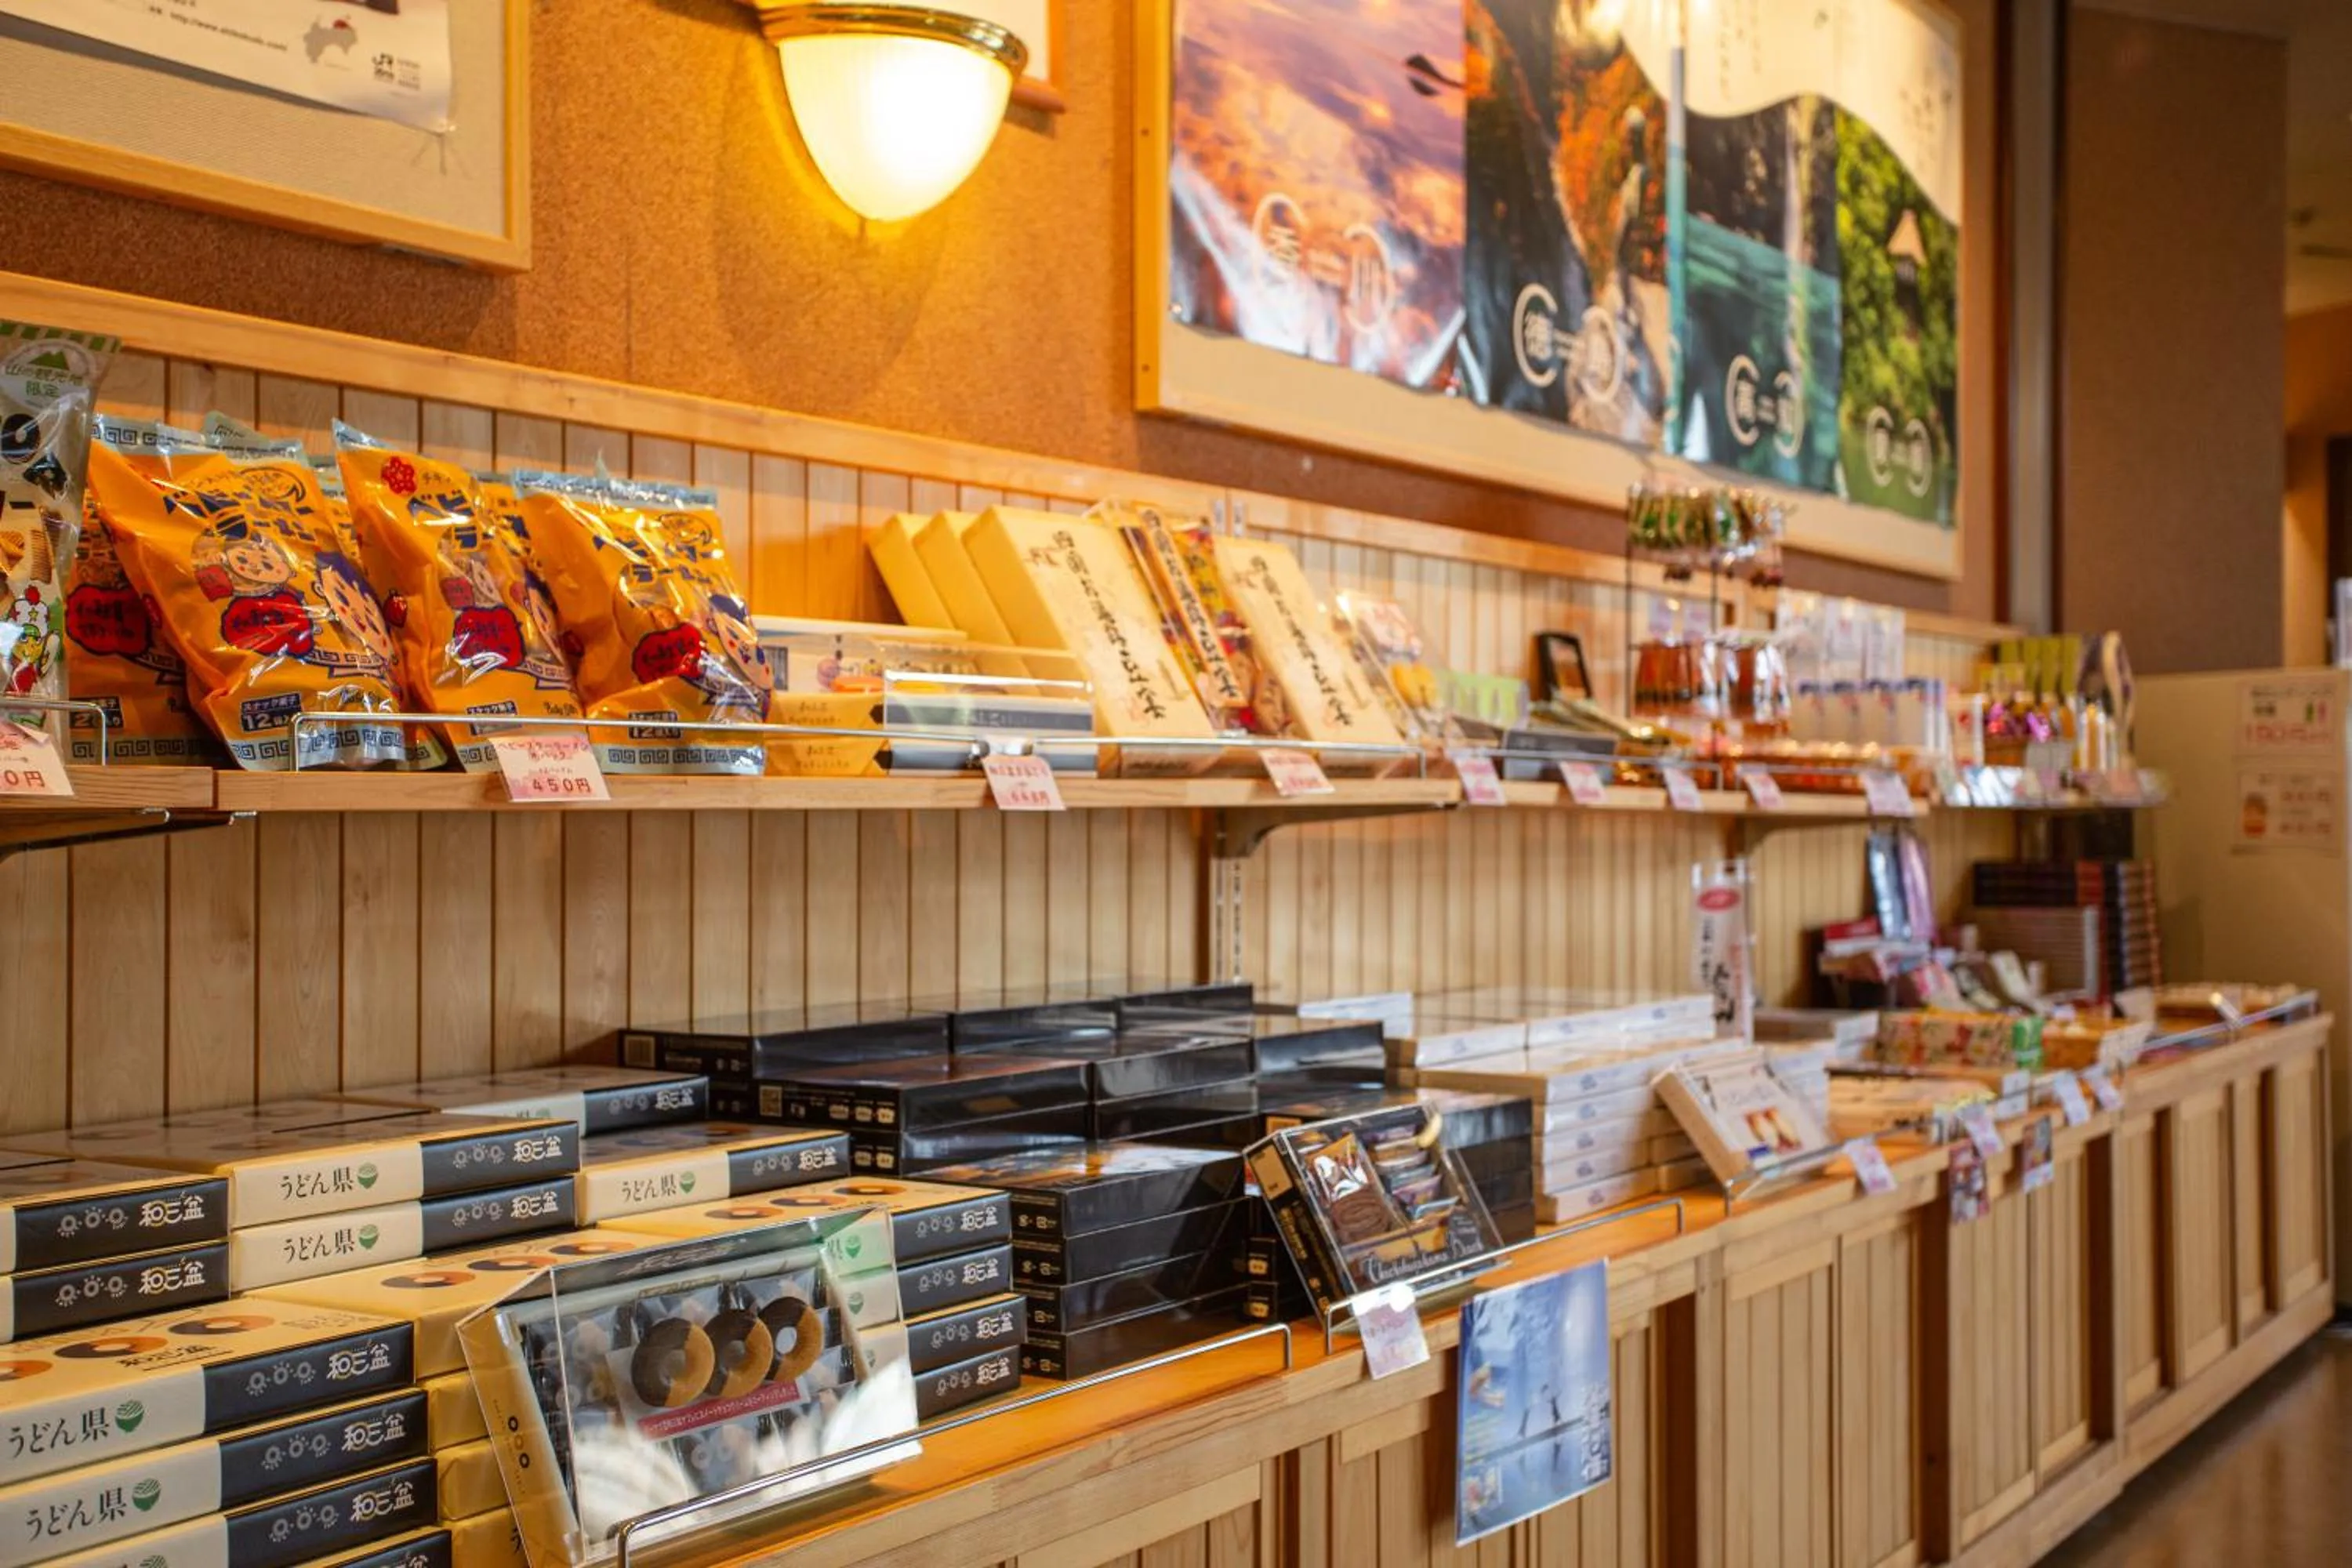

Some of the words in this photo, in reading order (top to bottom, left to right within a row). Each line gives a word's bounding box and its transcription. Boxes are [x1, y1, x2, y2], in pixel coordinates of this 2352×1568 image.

[532, 777, 591, 793] 450円
[512, 1135, 563, 1163] 和三盆
[798, 1146, 837, 1170] 和三盆
[281, 1167, 354, 1200] うどん県
[621, 1173, 677, 1203] うどん県
[139, 1195, 205, 1227] 和三盆
[510, 1191, 559, 1218] 和三盆
[960, 1206, 999, 1231] 和三盆
[283, 1229, 354, 1264] うどん県
[138, 1261, 205, 1294] 和三盆
[963, 1258, 999, 1284] 和三盆
[976, 1312, 1014, 1339] 和三盆
[326, 1343, 390, 1380] 和三盆
[976, 1356, 1011, 1385] 和三盆
[9, 1407, 109, 1461] うどん県
[342, 1413, 406, 1451] 和三盆
[27, 1487, 127, 1544] うどん県
[350, 1481, 415, 1522] 和三盆
